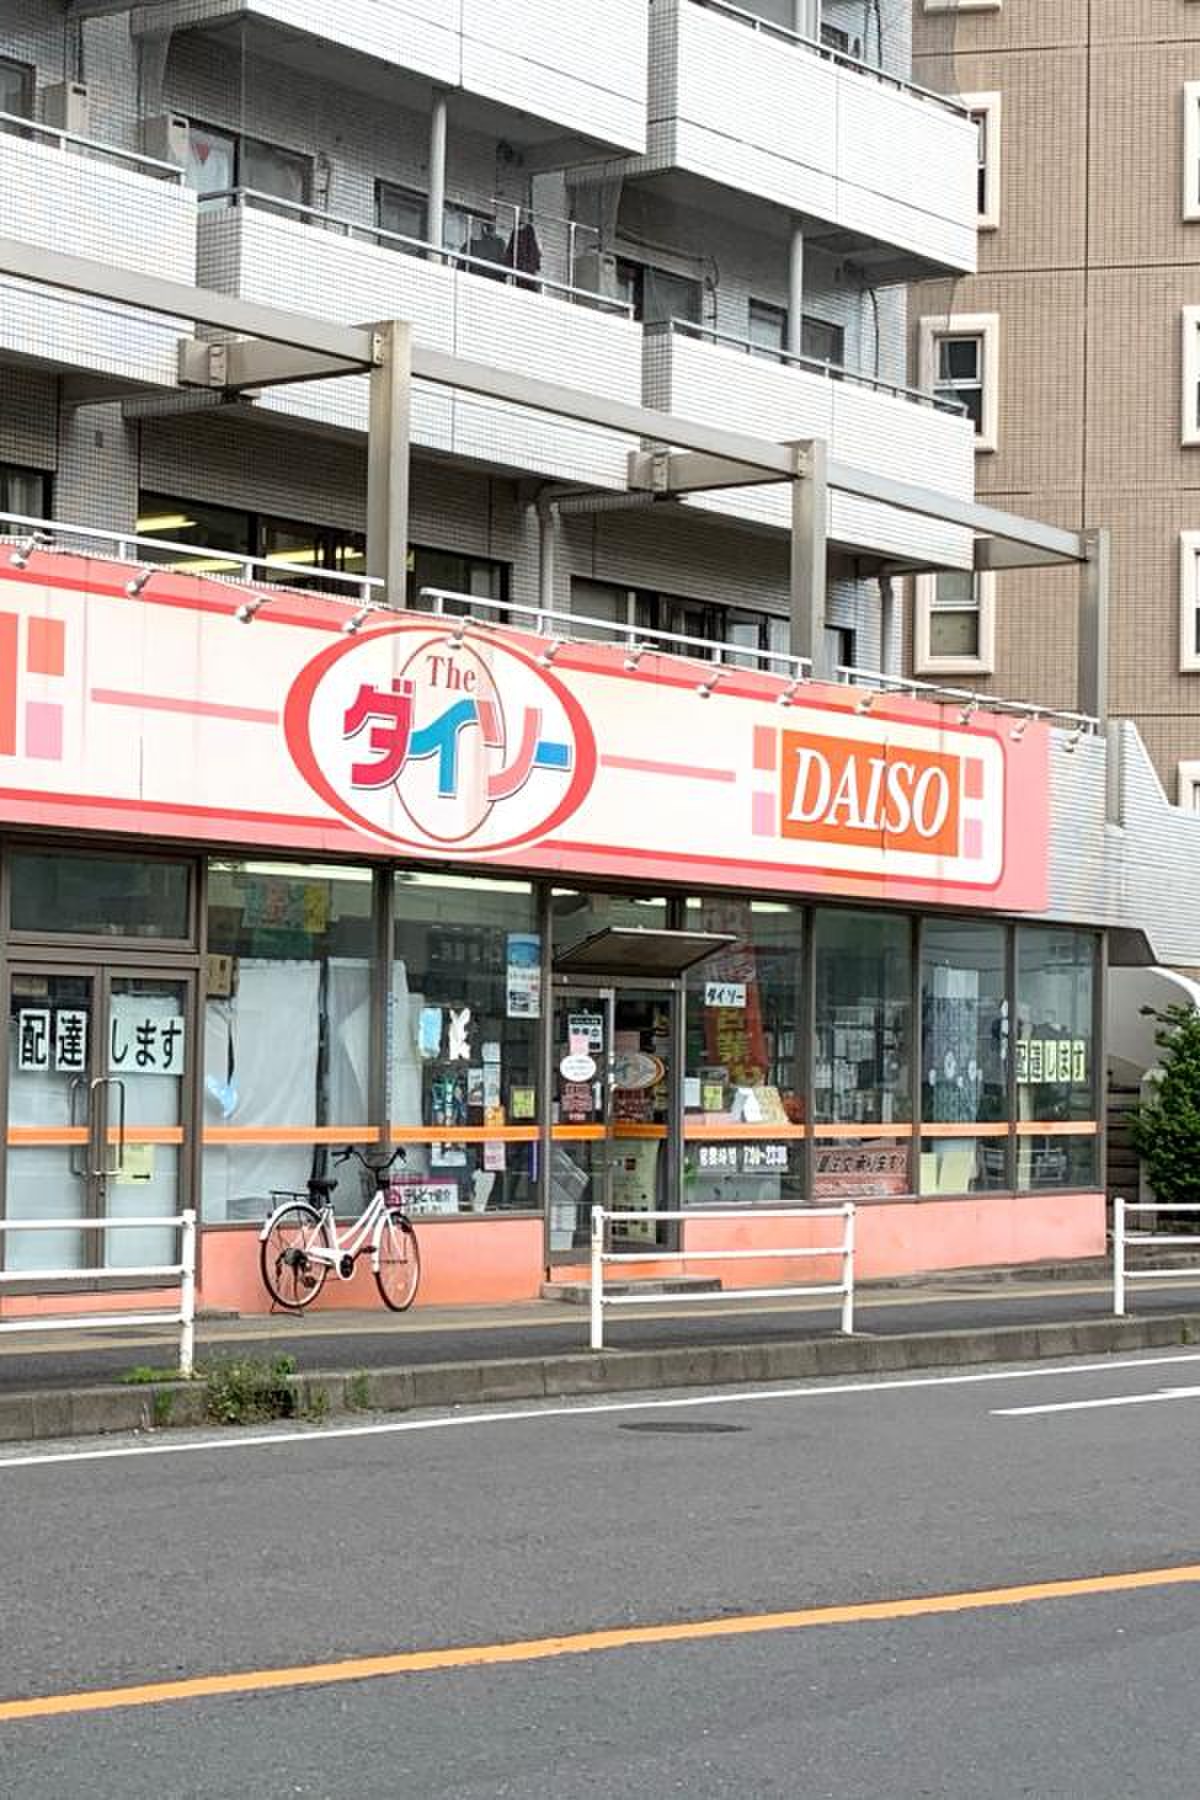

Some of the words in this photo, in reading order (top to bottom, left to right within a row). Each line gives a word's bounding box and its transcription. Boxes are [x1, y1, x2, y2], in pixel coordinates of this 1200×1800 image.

[427, 655, 476, 692] The
[343, 678, 571, 802] ダイソー
[785, 747, 949, 839] DAISO
[707, 988, 744, 1001] ダイソー
[22, 1014, 182, 1068] 配達します
